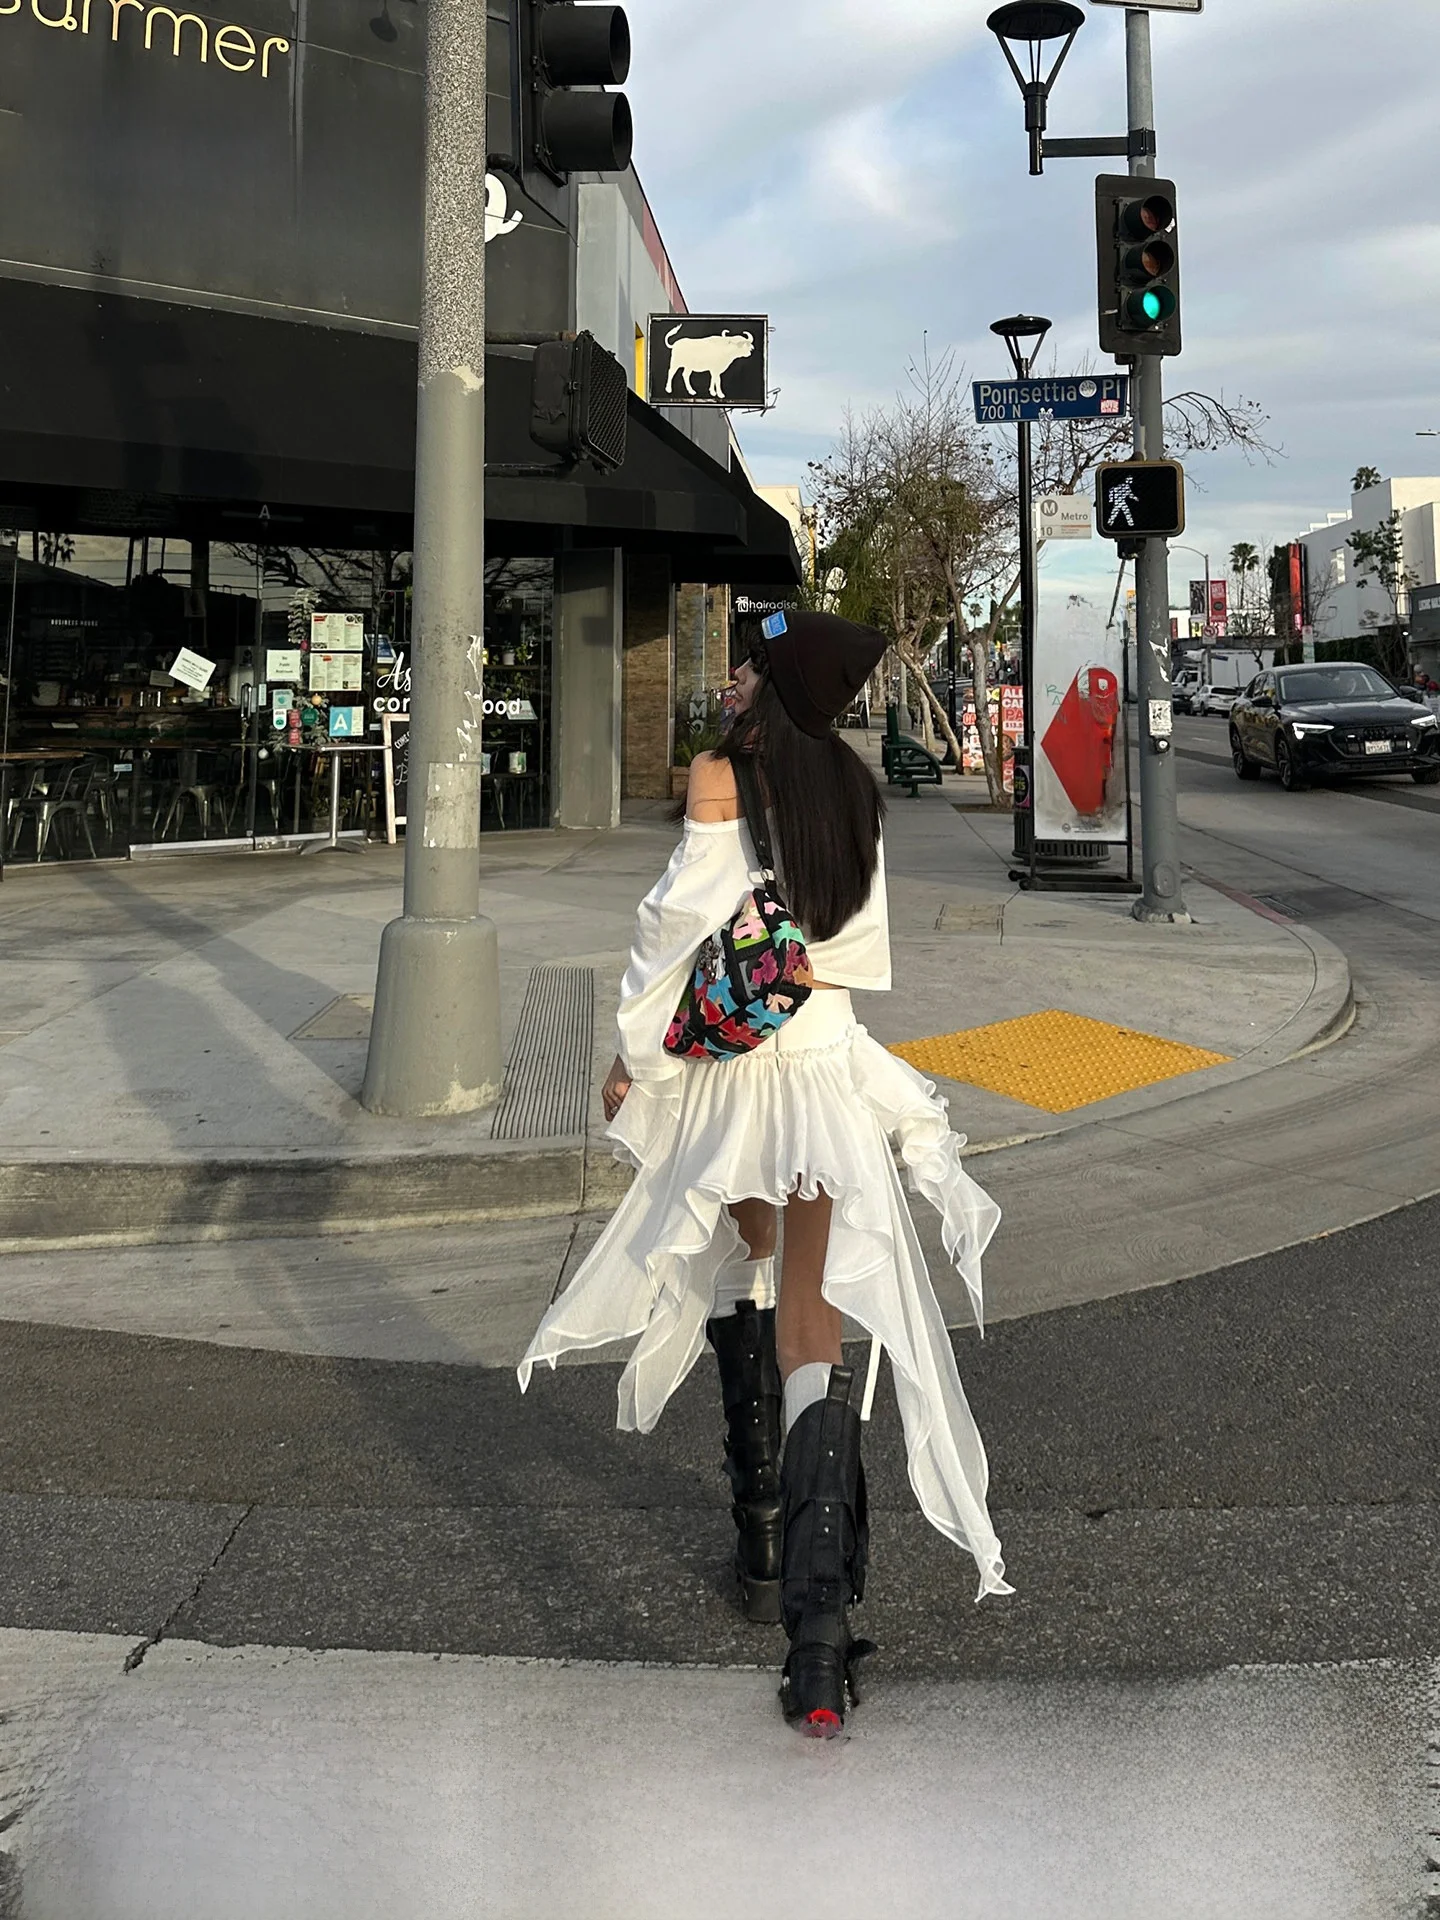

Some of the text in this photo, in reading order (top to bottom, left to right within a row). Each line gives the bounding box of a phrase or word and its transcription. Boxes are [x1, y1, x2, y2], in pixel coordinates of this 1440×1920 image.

[979, 382, 1077, 406] Poinsettia
[980, 404, 1021, 420] 700 N
[1061, 512, 1088, 521] Metro
[1040, 526, 1053, 537] 10
[333, 713, 348, 731] A
